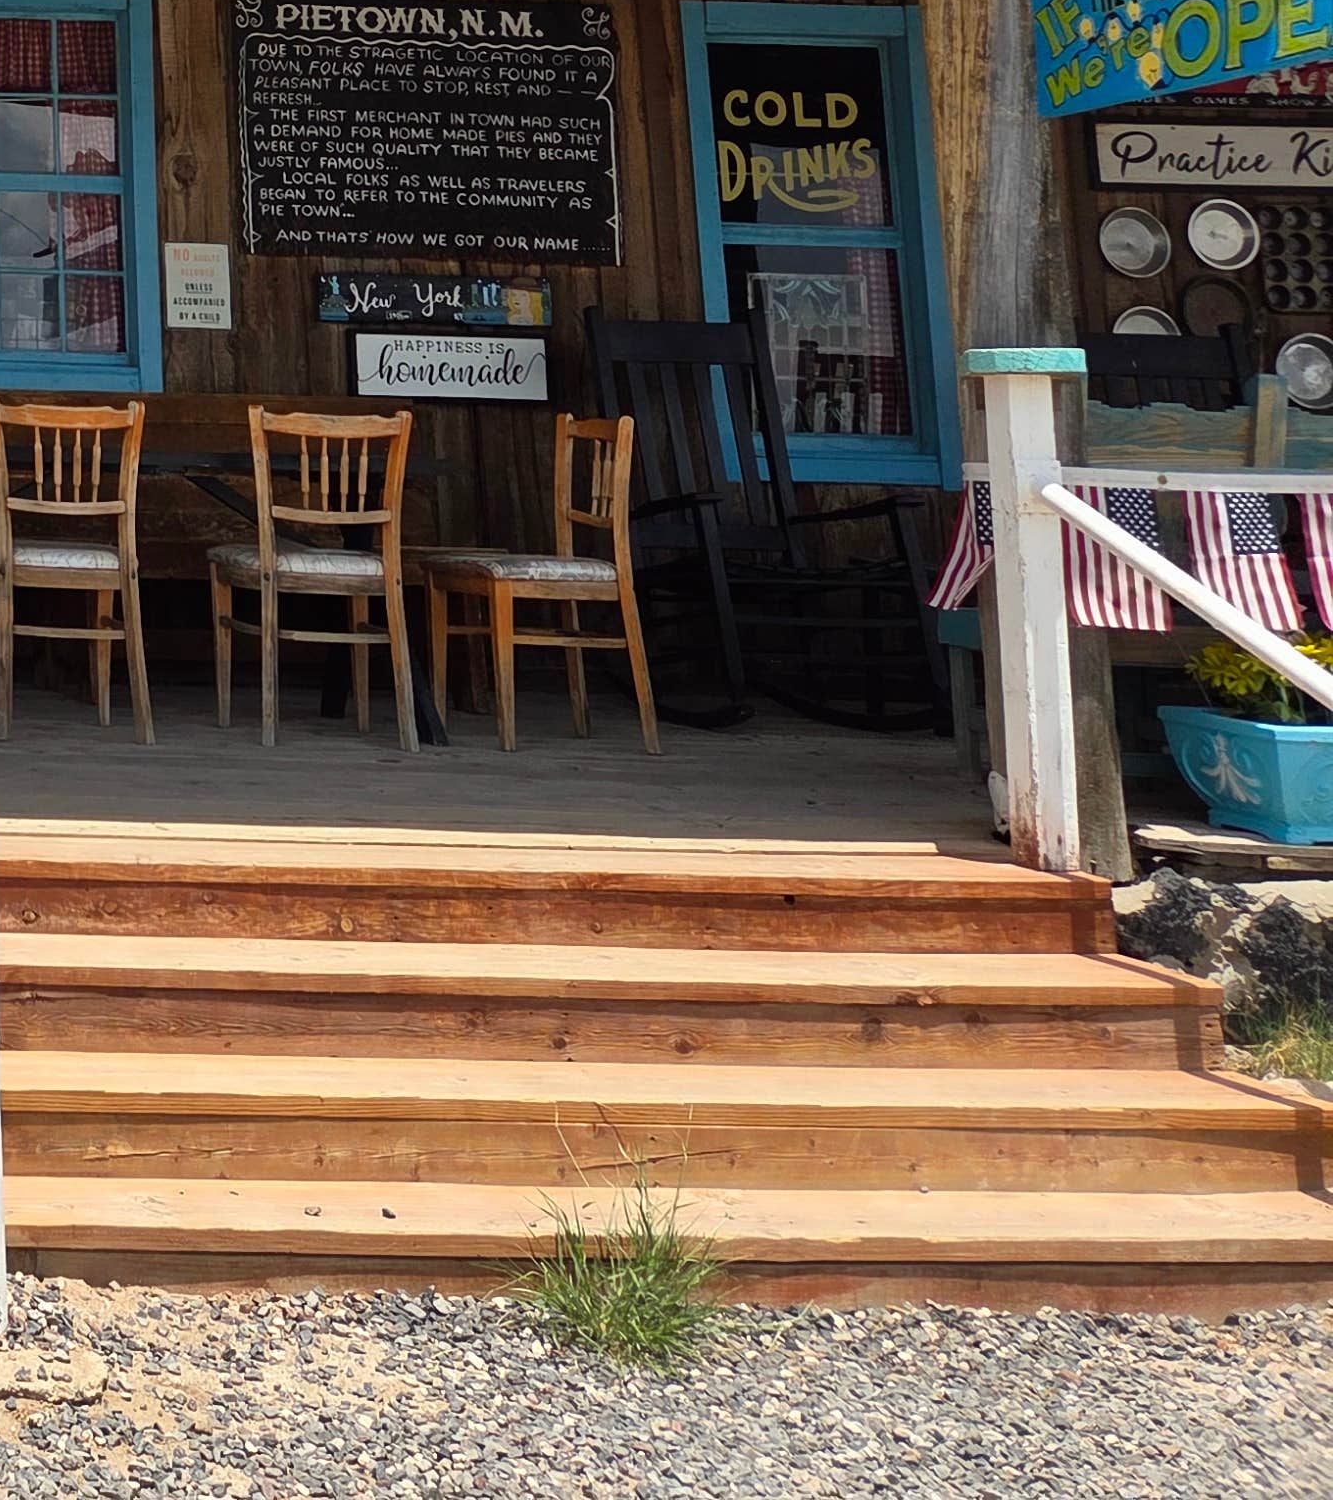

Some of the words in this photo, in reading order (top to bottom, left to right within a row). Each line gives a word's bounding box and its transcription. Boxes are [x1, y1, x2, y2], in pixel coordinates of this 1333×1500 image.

[258, 43, 287, 57] DUE
[293, 44, 312, 56] TO
[316, 45, 342, 57] THE
[348, 46, 444, 60] STRAGETIC
[456, 51, 543, 65] LOCATION
[552, 54, 574, 65] OF
[579, 55, 612, 68] OUR
[1044, 24, 1151, 108] We're
[249, 58, 303, 76] TOWN,
[309, 60, 365, 77] FOLKS
[374, 63, 416, 76] HAVE
[423, 64, 491, 78] ALWAYS
[499, 67, 556, 81] FOUND
[565, 70, 578, 82] IT
[586, 71, 597, 82] A
[254, 75, 332, 90] PLEASANT
[339, 78, 391, 91] PLACE
[398, 79, 418, 92] TO
[423, 80, 469, 96] STOP,
[475, 83, 510, 97] REST,
[517, 84, 551, 96] AND
[723, 88, 859, 129] COLD
[1192, 95, 1250, 105] GAMES
[270, 108, 299, 121] THE
[307, 109, 347, 122] FIRST
[355, 110, 441, 124] MERCHANT
[450, 112, 464, 125] IN
[468, 113, 515, 126] TOWN
[521, 116, 552, 128] HAD
[558, 117, 601, 130] SUCH
[253, 124, 265, 136] A
[270, 124, 341, 138] DEMAND
[351, 126, 383, 138] FOR
[389, 127, 434, 139] HOME
[443, 129, 490, 142] MADE
[495, 130, 525, 143] PIES
[533, 132, 562, 144] AND
[568, 133, 603, 146] THEY
[254, 140, 295, 152] WERE
[300, 141, 319, 152] OF
[325, 141, 365, 153] SUCH
[372, 142, 442, 156] QUALITY
[451, 144, 490, 157] THAT
[497, 146, 532, 160] THEY
[539, 148, 599, 162] BECAME
[258, 156, 311, 168] JUSTLY
[1110, 131, 1272, 179] Practice
[283, 172, 337, 185] LOCAL
[346, 173, 389, 186] FOLKS
[399, 175, 420, 188] AS
[427, 175, 466, 189] WELL
[471, 177, 491, 190] AS
[496, 177, 587, 193] TRAVELERS
[717, 137, 877, 212] DRINKS
[260, 188, 306, 200] BEGAN
[315, 189, 335, 201] TO
[344, 189, 388, 204] REFER
[395, 190, 415, 203] TO
[419, 191, 449, 204] THE
[456, 192, 558, 208] COMMUNITY
[569, 197, 593, 210] AS
[276, 229, 312, 242] AND
[376, 232, 414, 245] HOW
[423, 234, 447, 247] WE
[454, 234, 484, 247] GOT
[493, 235, 529, 250] OUR
[173, 248, 190, 261] NO
[184, 282, 213, 291] UNLESS
[173, 297, 225, 307] ACCOMPANIED
[345, 282, 396, 313] New
[412, 282, 464, 318] York
[179, 312, 189, 320] BY
[192, 312, 196, 320] A
[199, 313, 220, 321] CHILD
[393, 339, 483, 354] HAPPINESS
[488, 343, 505, 355] IS
[365, 344, 539, 387] homemade
